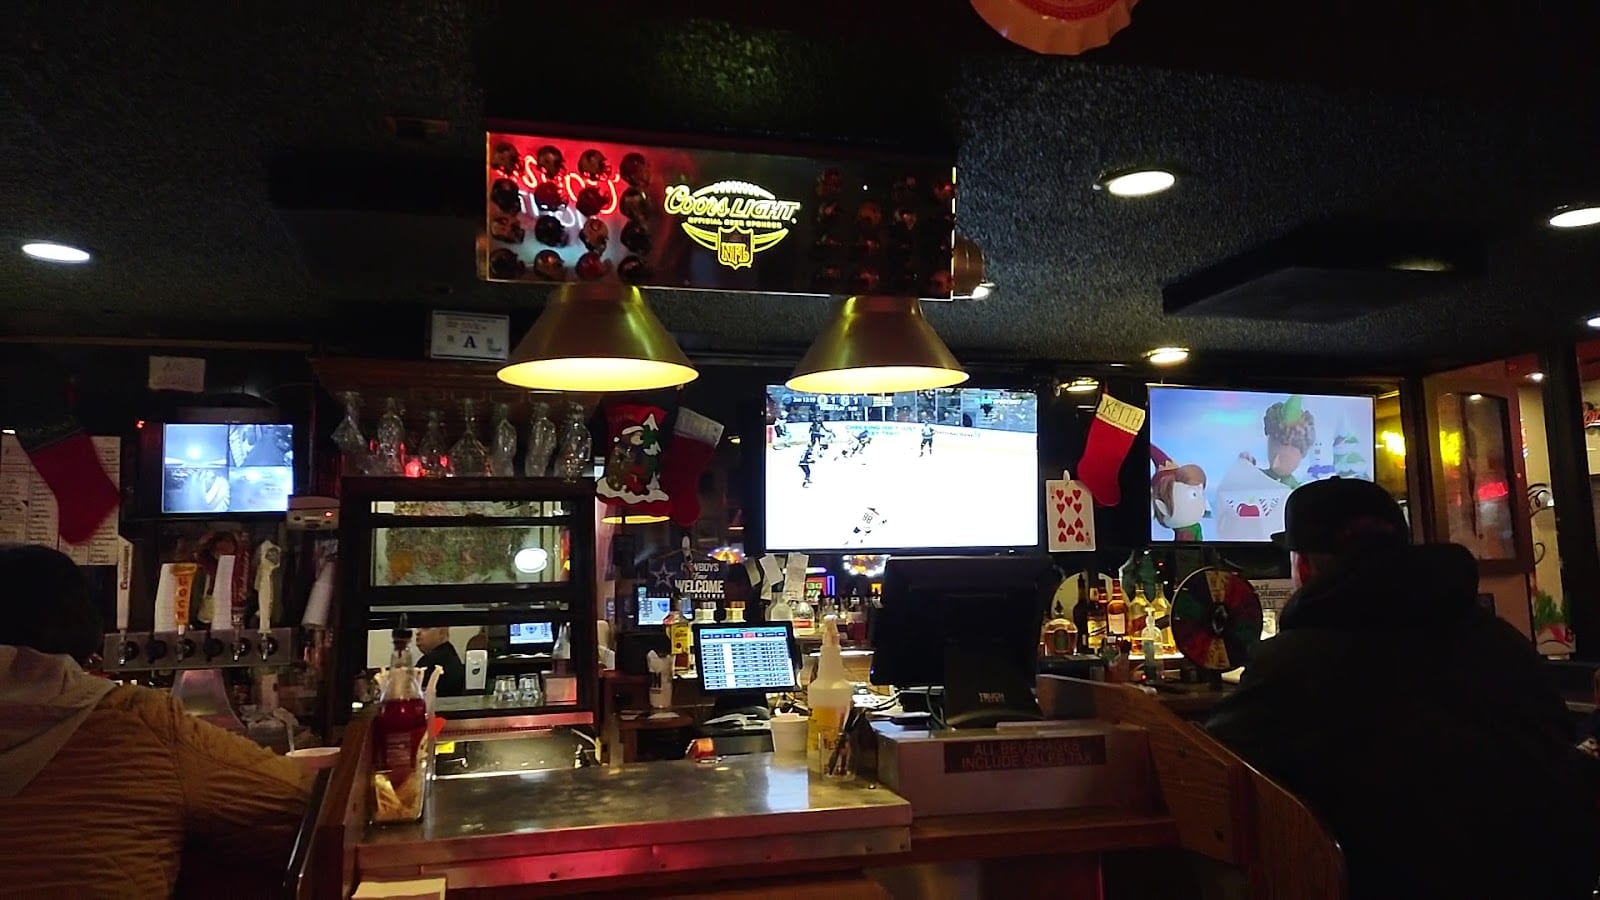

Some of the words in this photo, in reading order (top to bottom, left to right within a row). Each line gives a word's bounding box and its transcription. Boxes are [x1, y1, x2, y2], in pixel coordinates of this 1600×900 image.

[721, 242, 750, 264] NFL
[463, 335, 477, 349] A
[1102, 399, 1144, 428] KEITH
[681, 562, 719, 572] CWBOYS
[674, 579, 724, 593] WELCOME
[973, 743, 995, 755] ALL
[1001, 741, 1081, 754] BEVERAGES
[961, 755, 1020, 770] INCLUDE
[1024, 753, 1066, 768] SALES
